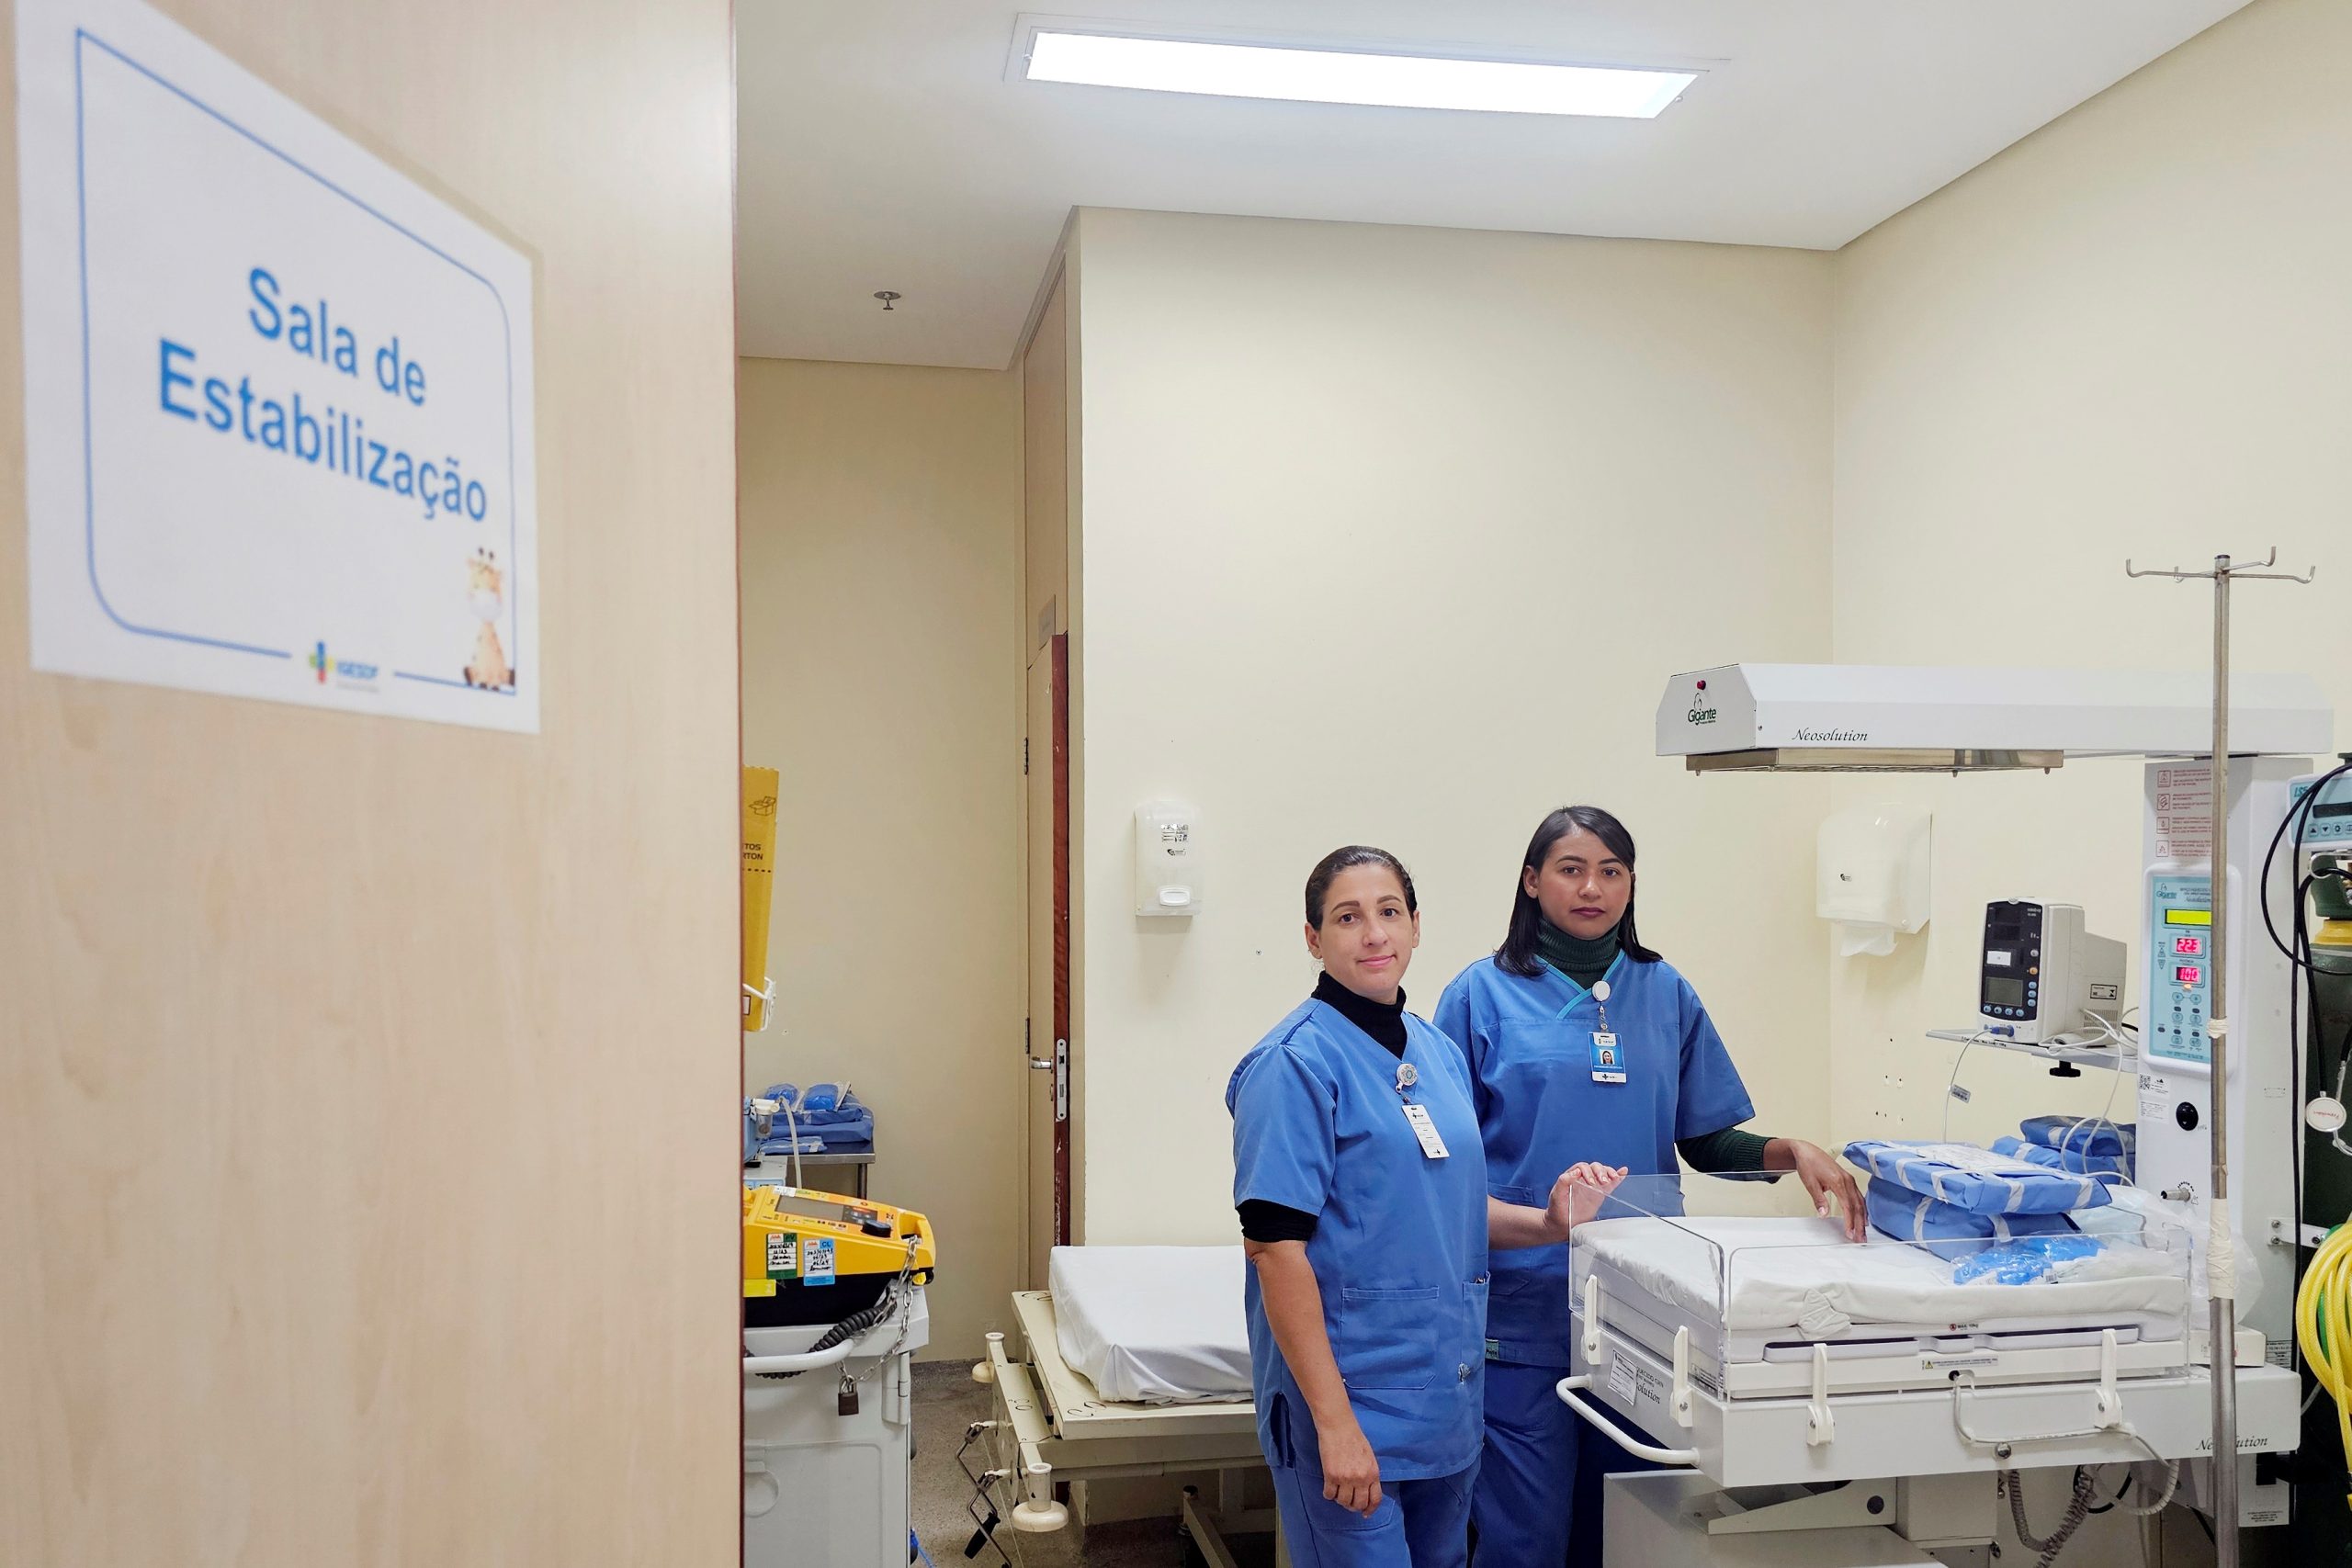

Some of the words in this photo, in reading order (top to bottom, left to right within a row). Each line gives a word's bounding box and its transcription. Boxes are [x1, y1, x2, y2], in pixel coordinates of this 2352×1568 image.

[246, 265, 359, 378] Sala
[374, 337, 427, 407] de
[158, 336, 489, 523] Estabilização
[1688, 707, 1717, 726] Gigante
[1792, 728, 1869, 742] Neosolution
[2178, 967, 2200, 981] 100
